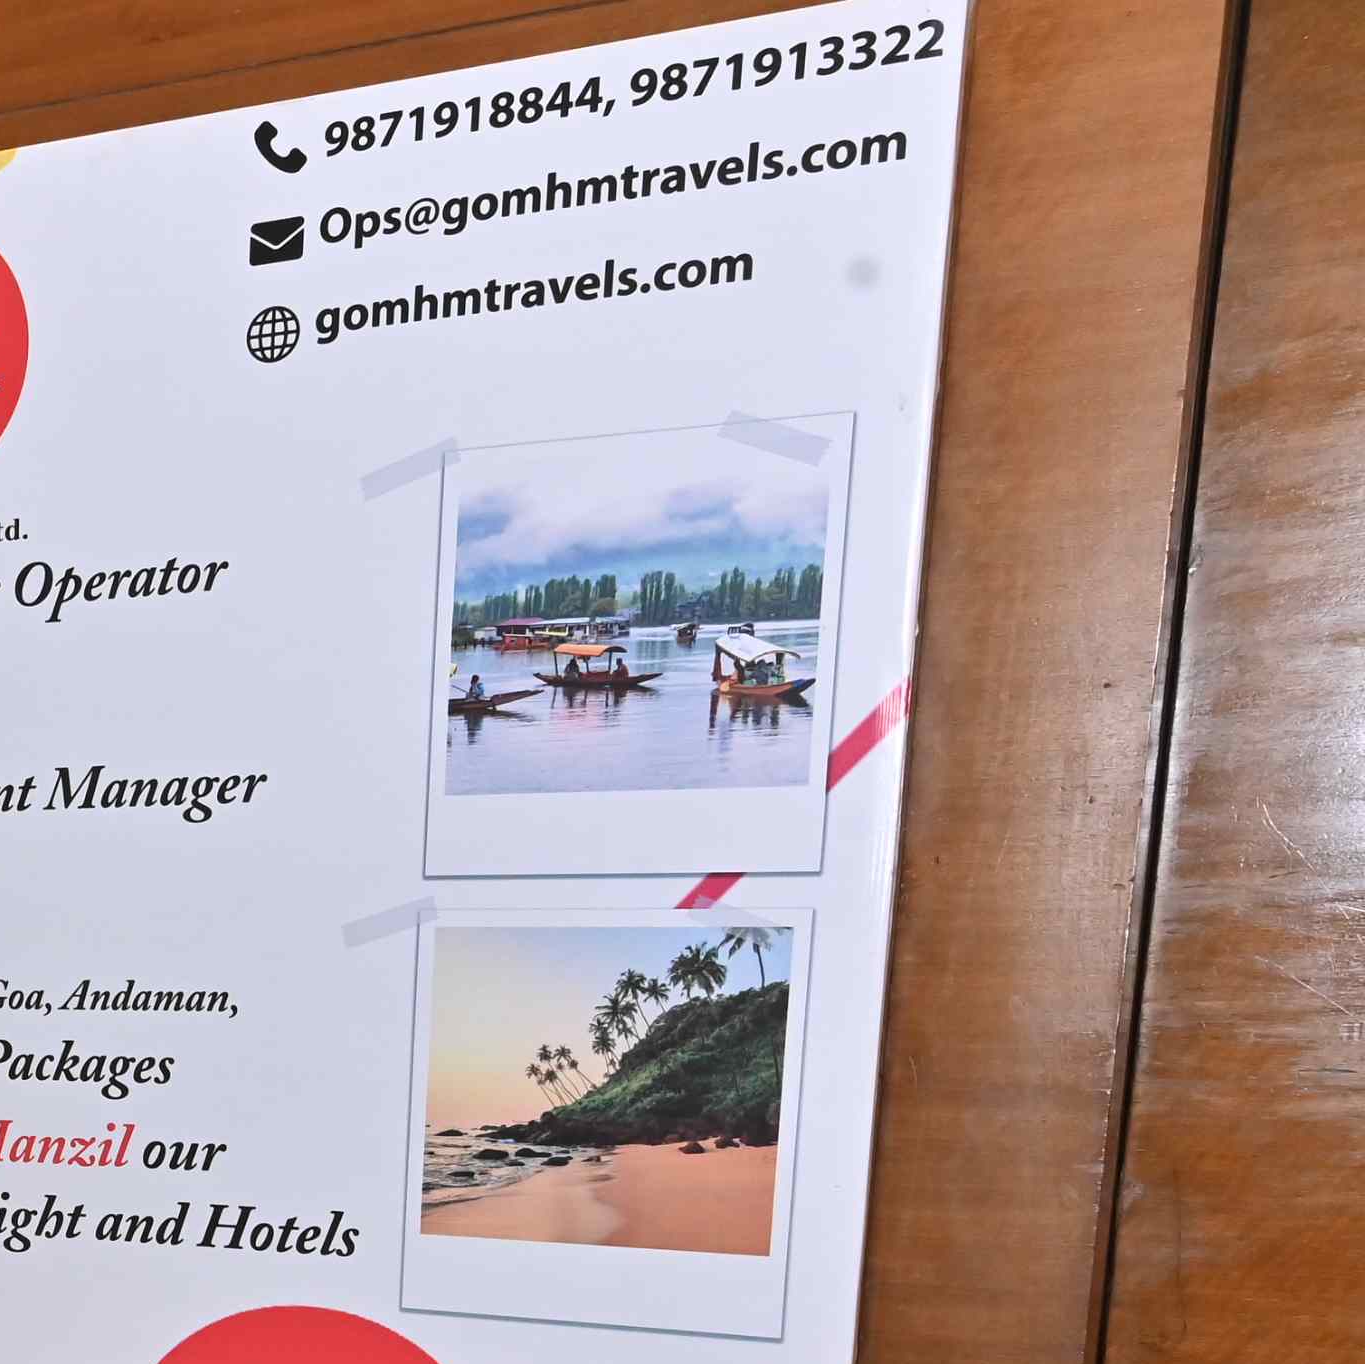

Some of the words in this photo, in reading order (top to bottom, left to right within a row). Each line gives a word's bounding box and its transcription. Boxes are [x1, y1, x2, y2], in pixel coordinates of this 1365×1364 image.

[325, 76, 616, 158] 9871918844,
[629, 18, 946, 108] 9871913322
[318, 130, 908, 247] Ops@gomhmtravels.com
[316, 247, 753, 344] gomhmtravels.com
[14, 554, 229, 624] Operator
[44, 764, 267, 824] Manager
[59, 979, 240, 1016] Andaman,
[142, 1137, 227, 1174] our
[96, 1196, 187, 1249] and
[196, 1201, 361, 1259] Hotels
